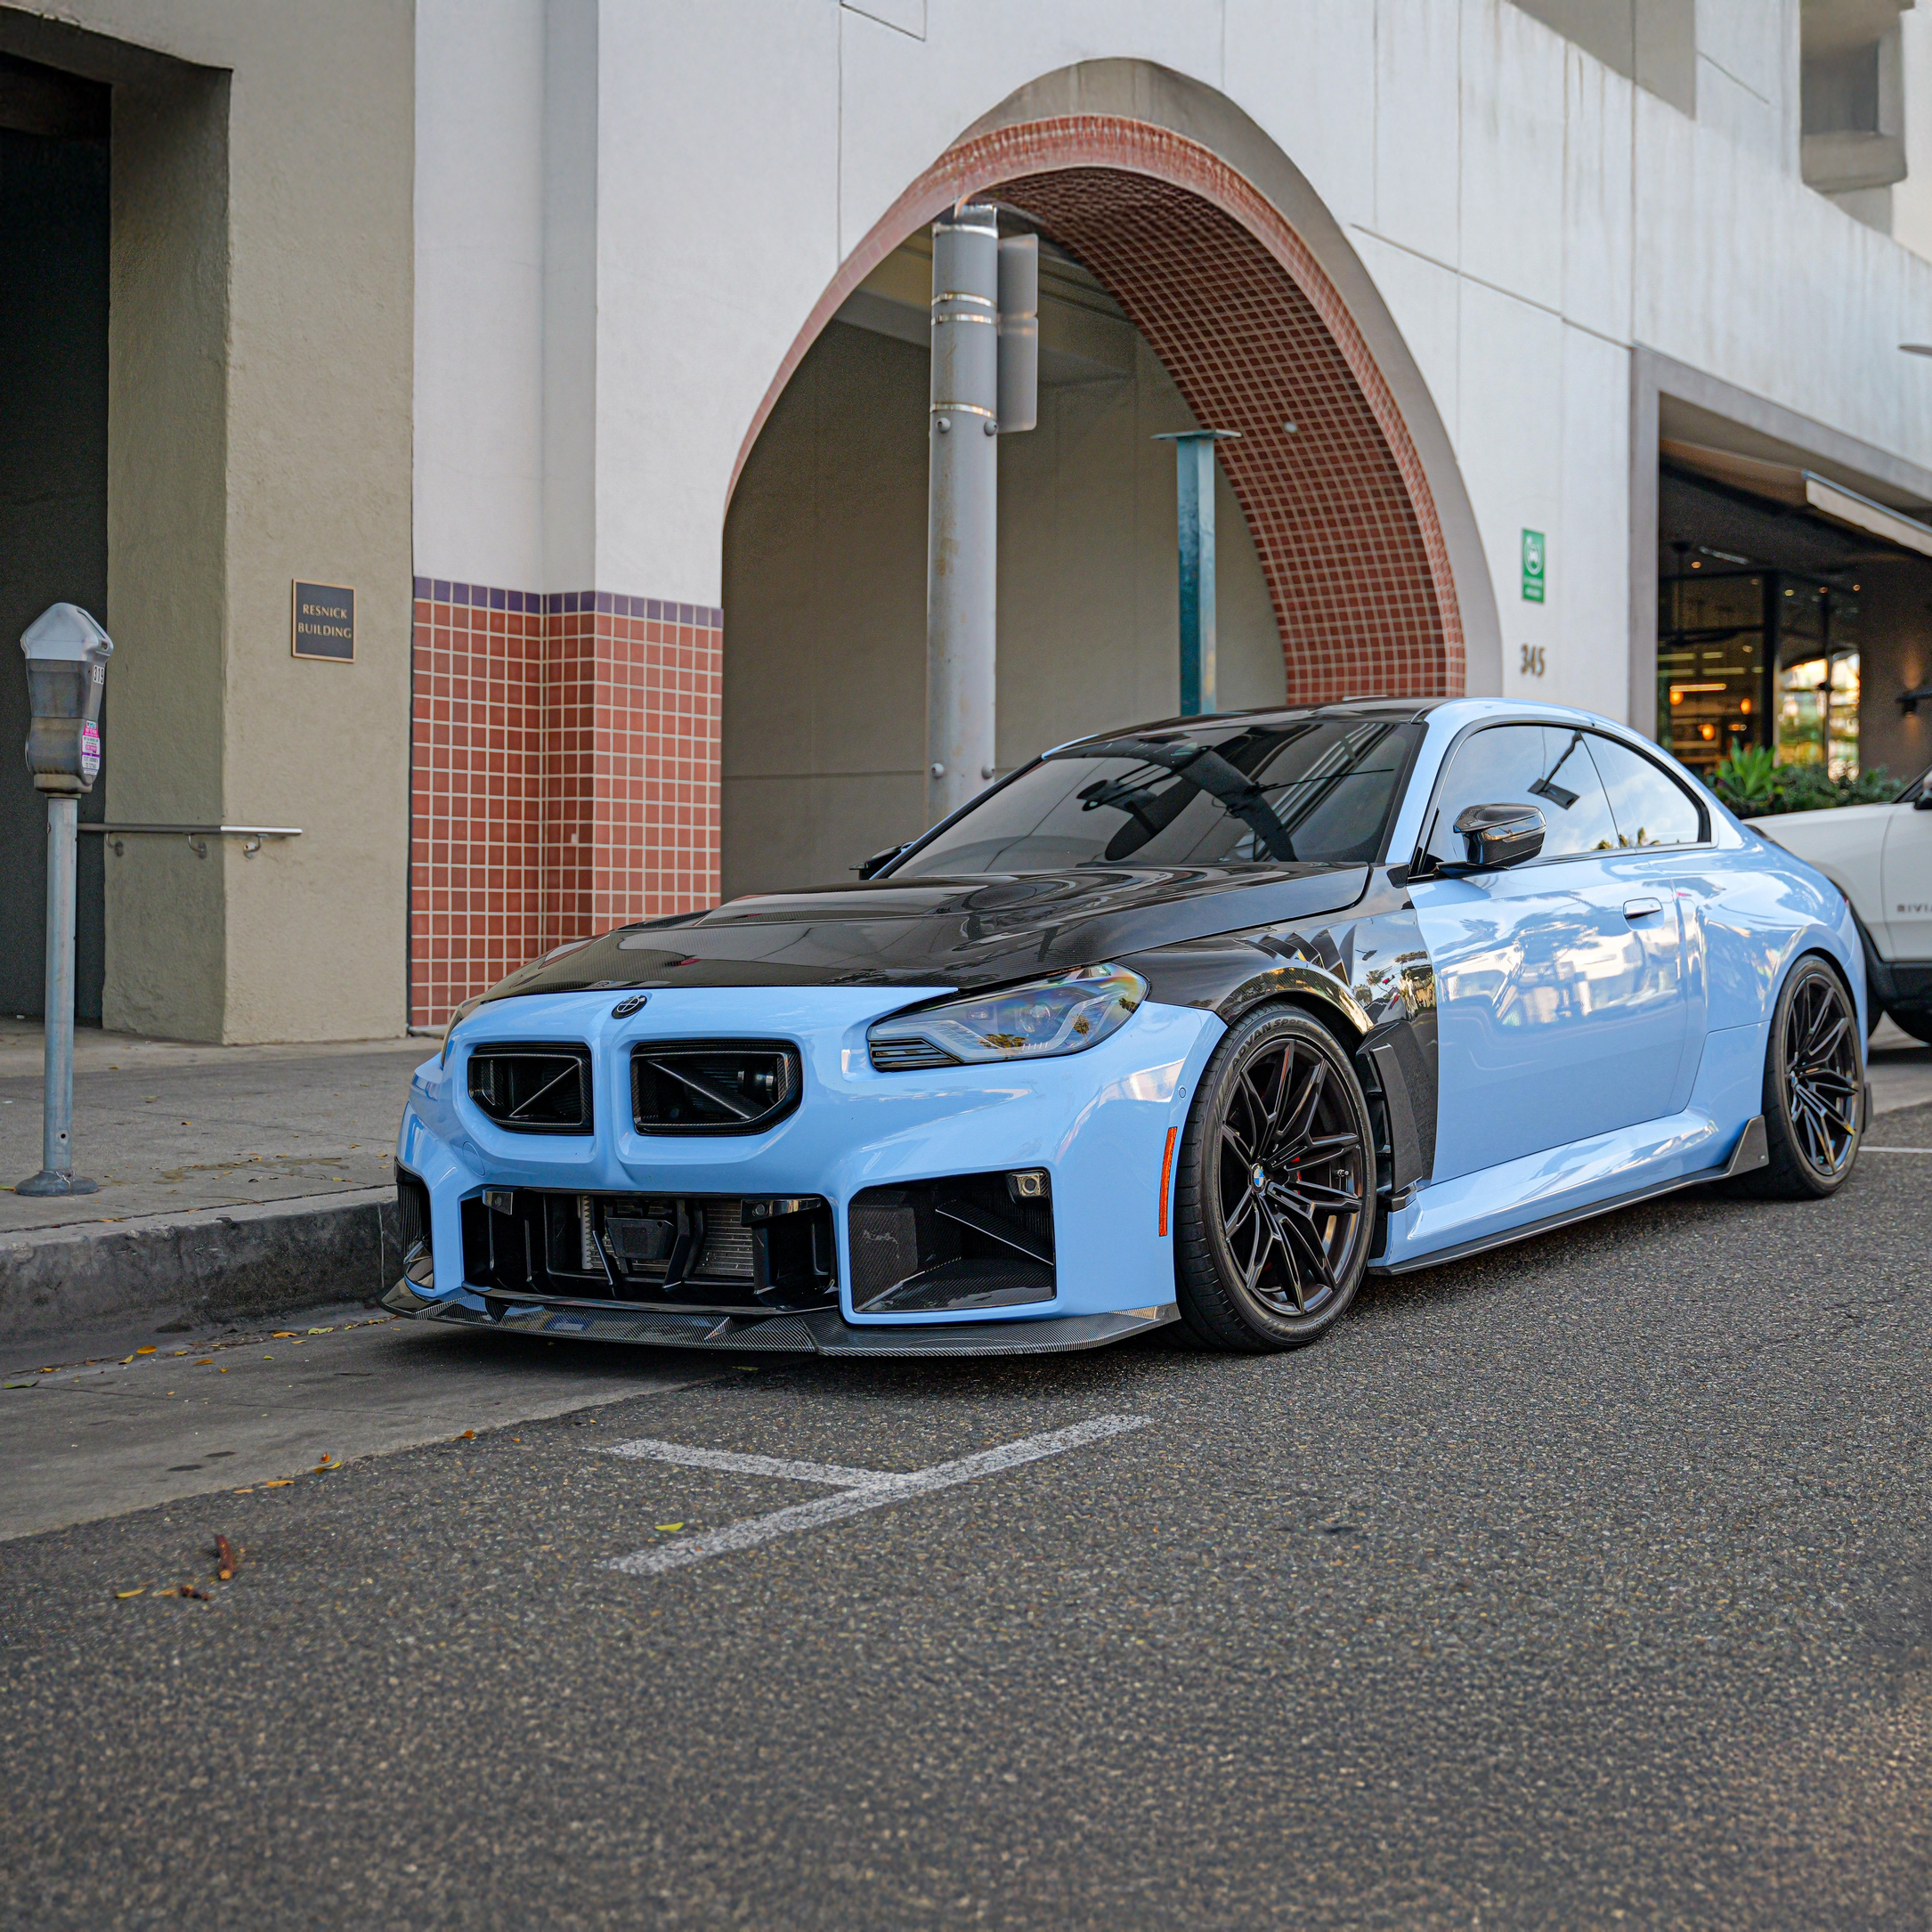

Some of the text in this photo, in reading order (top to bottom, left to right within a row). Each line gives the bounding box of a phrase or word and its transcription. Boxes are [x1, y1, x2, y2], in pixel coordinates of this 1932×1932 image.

[303, 604, 347, 620] RESNICK
[297, 621, 352, 639] BUILDING
[1521, 643, 1546, 678] 345
[94, 666, 104, 683] 319
[1897, 904, 1932, 913] RIVI
[1232, 1021, 1272, 1071] ADVAN
